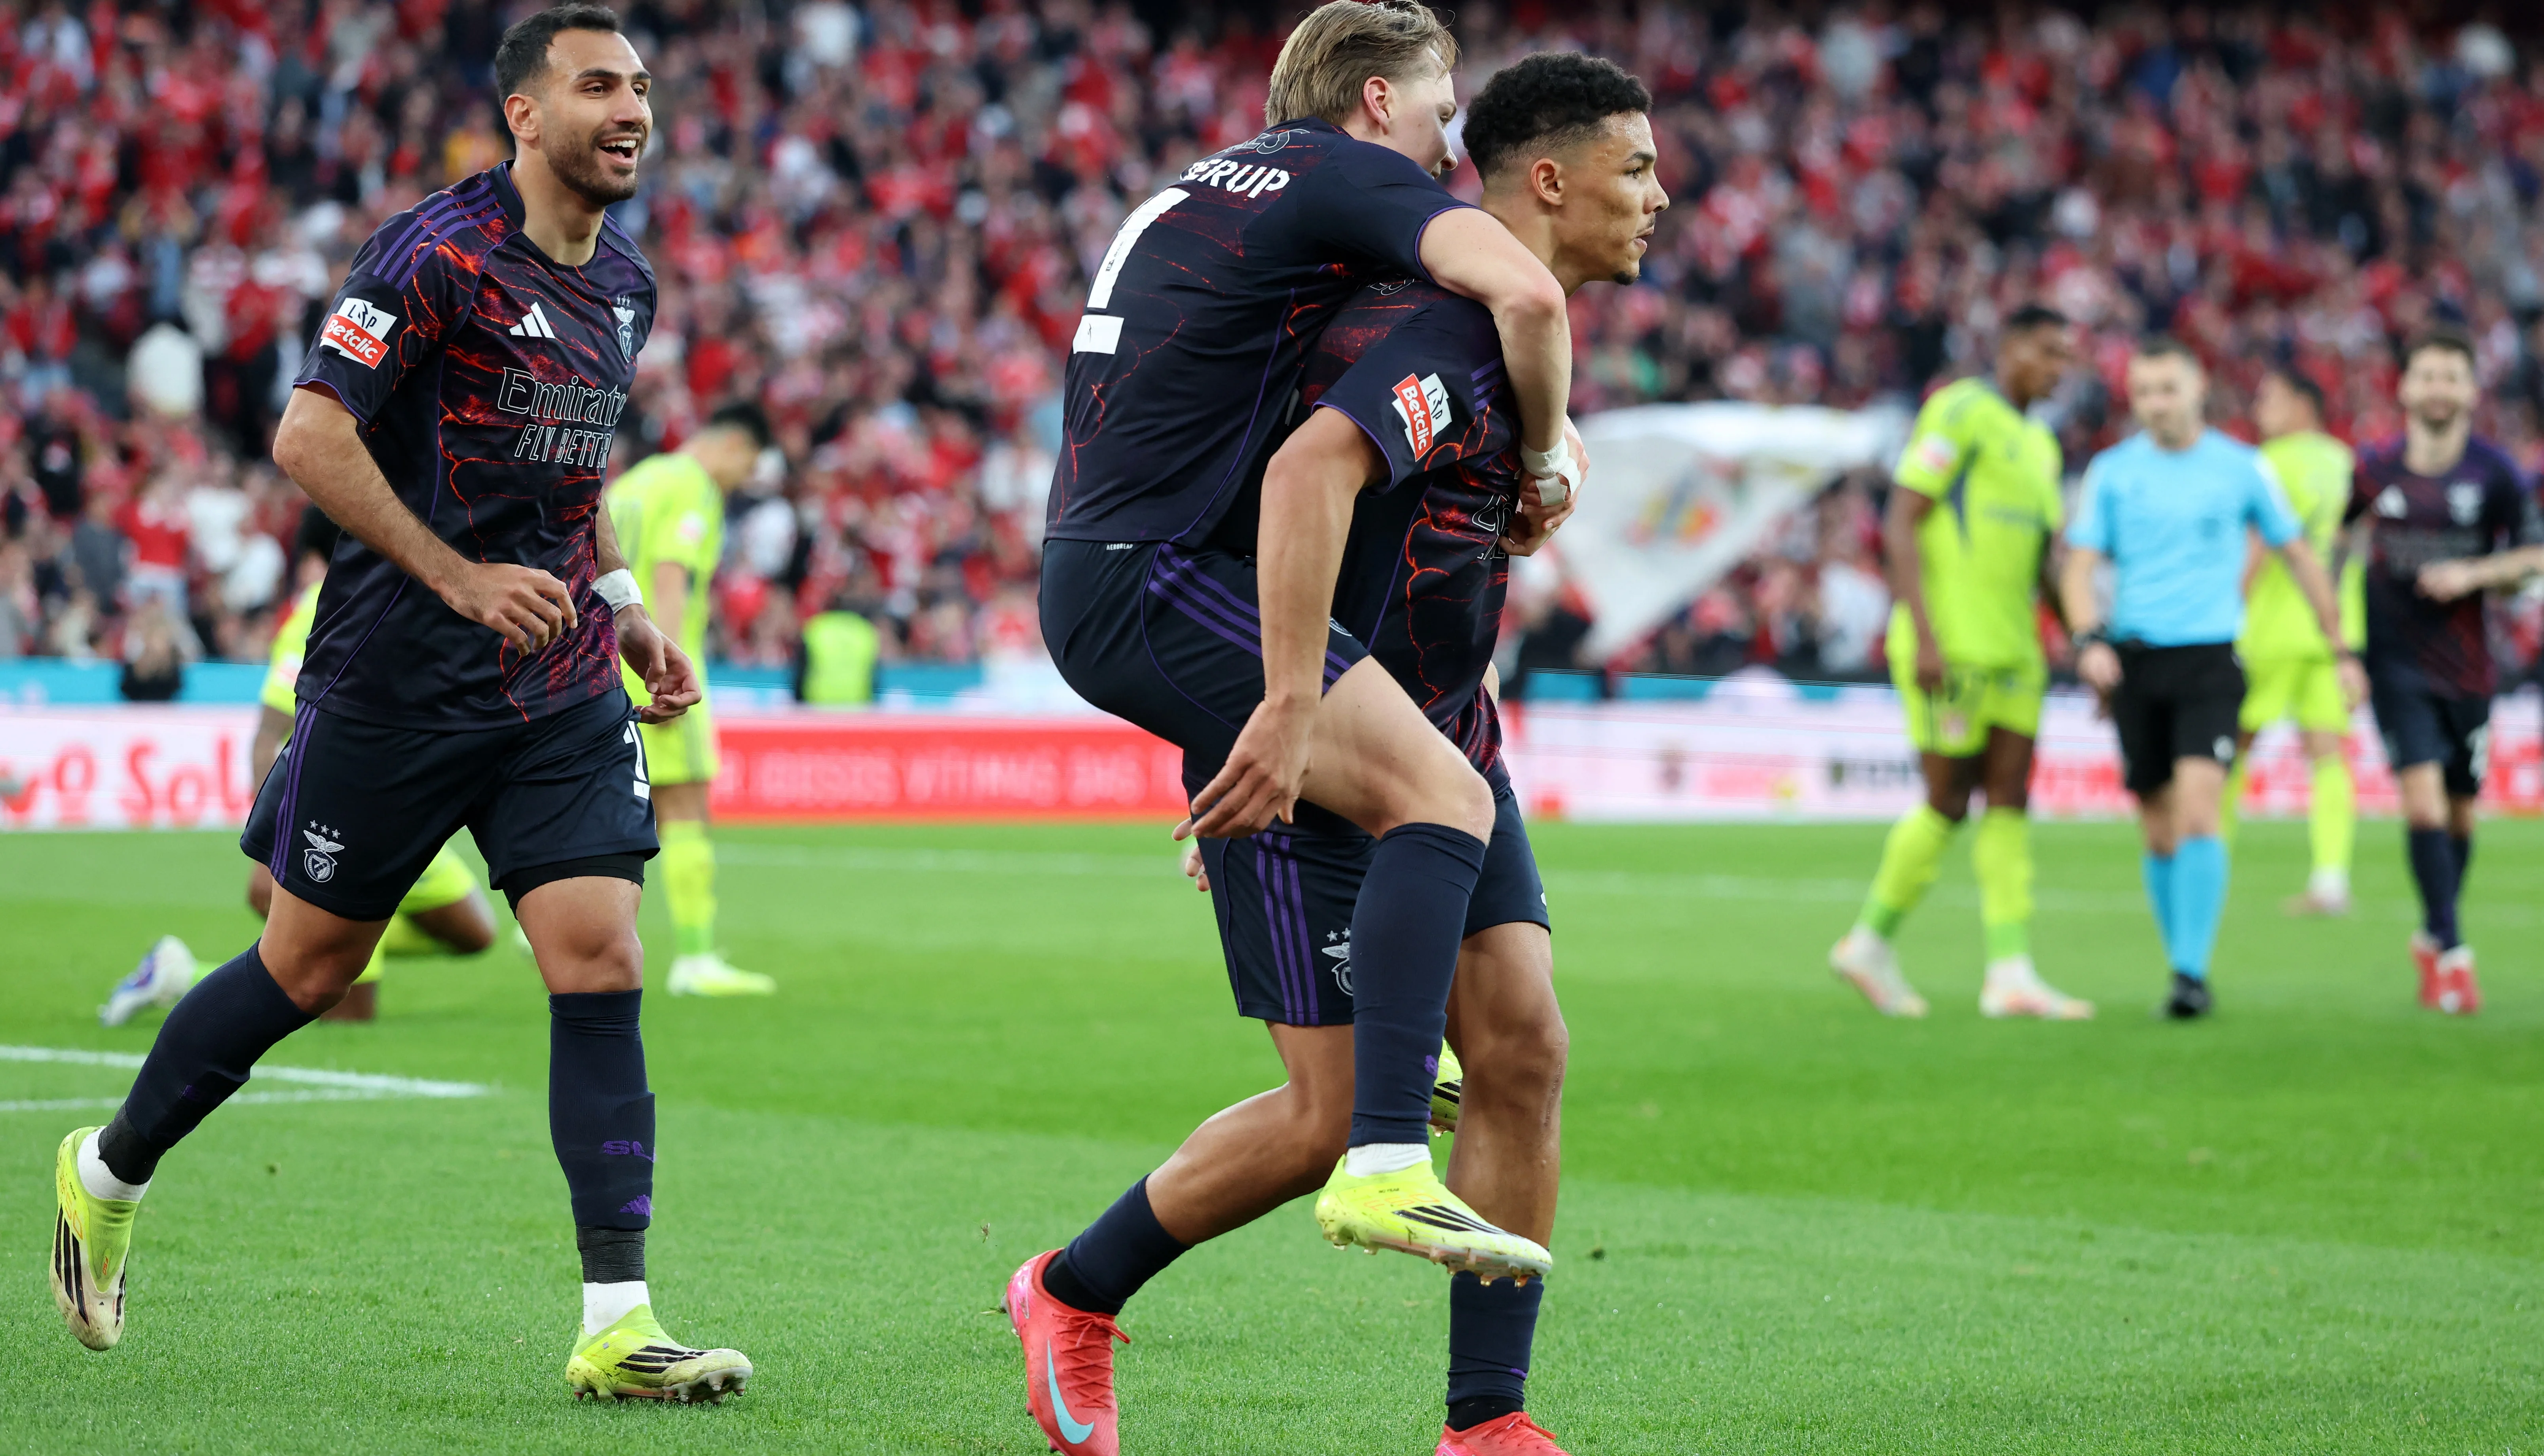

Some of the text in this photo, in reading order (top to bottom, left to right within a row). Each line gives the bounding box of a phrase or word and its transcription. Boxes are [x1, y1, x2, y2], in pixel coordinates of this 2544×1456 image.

[326, 319, 378, 359] Betclic
[497, 366, 628, 426] Emirate
[1401, 385, 1427, 451] Betclic
[514, 424, 556, 461] FLY
[122, 732, 254, 820] Sol
